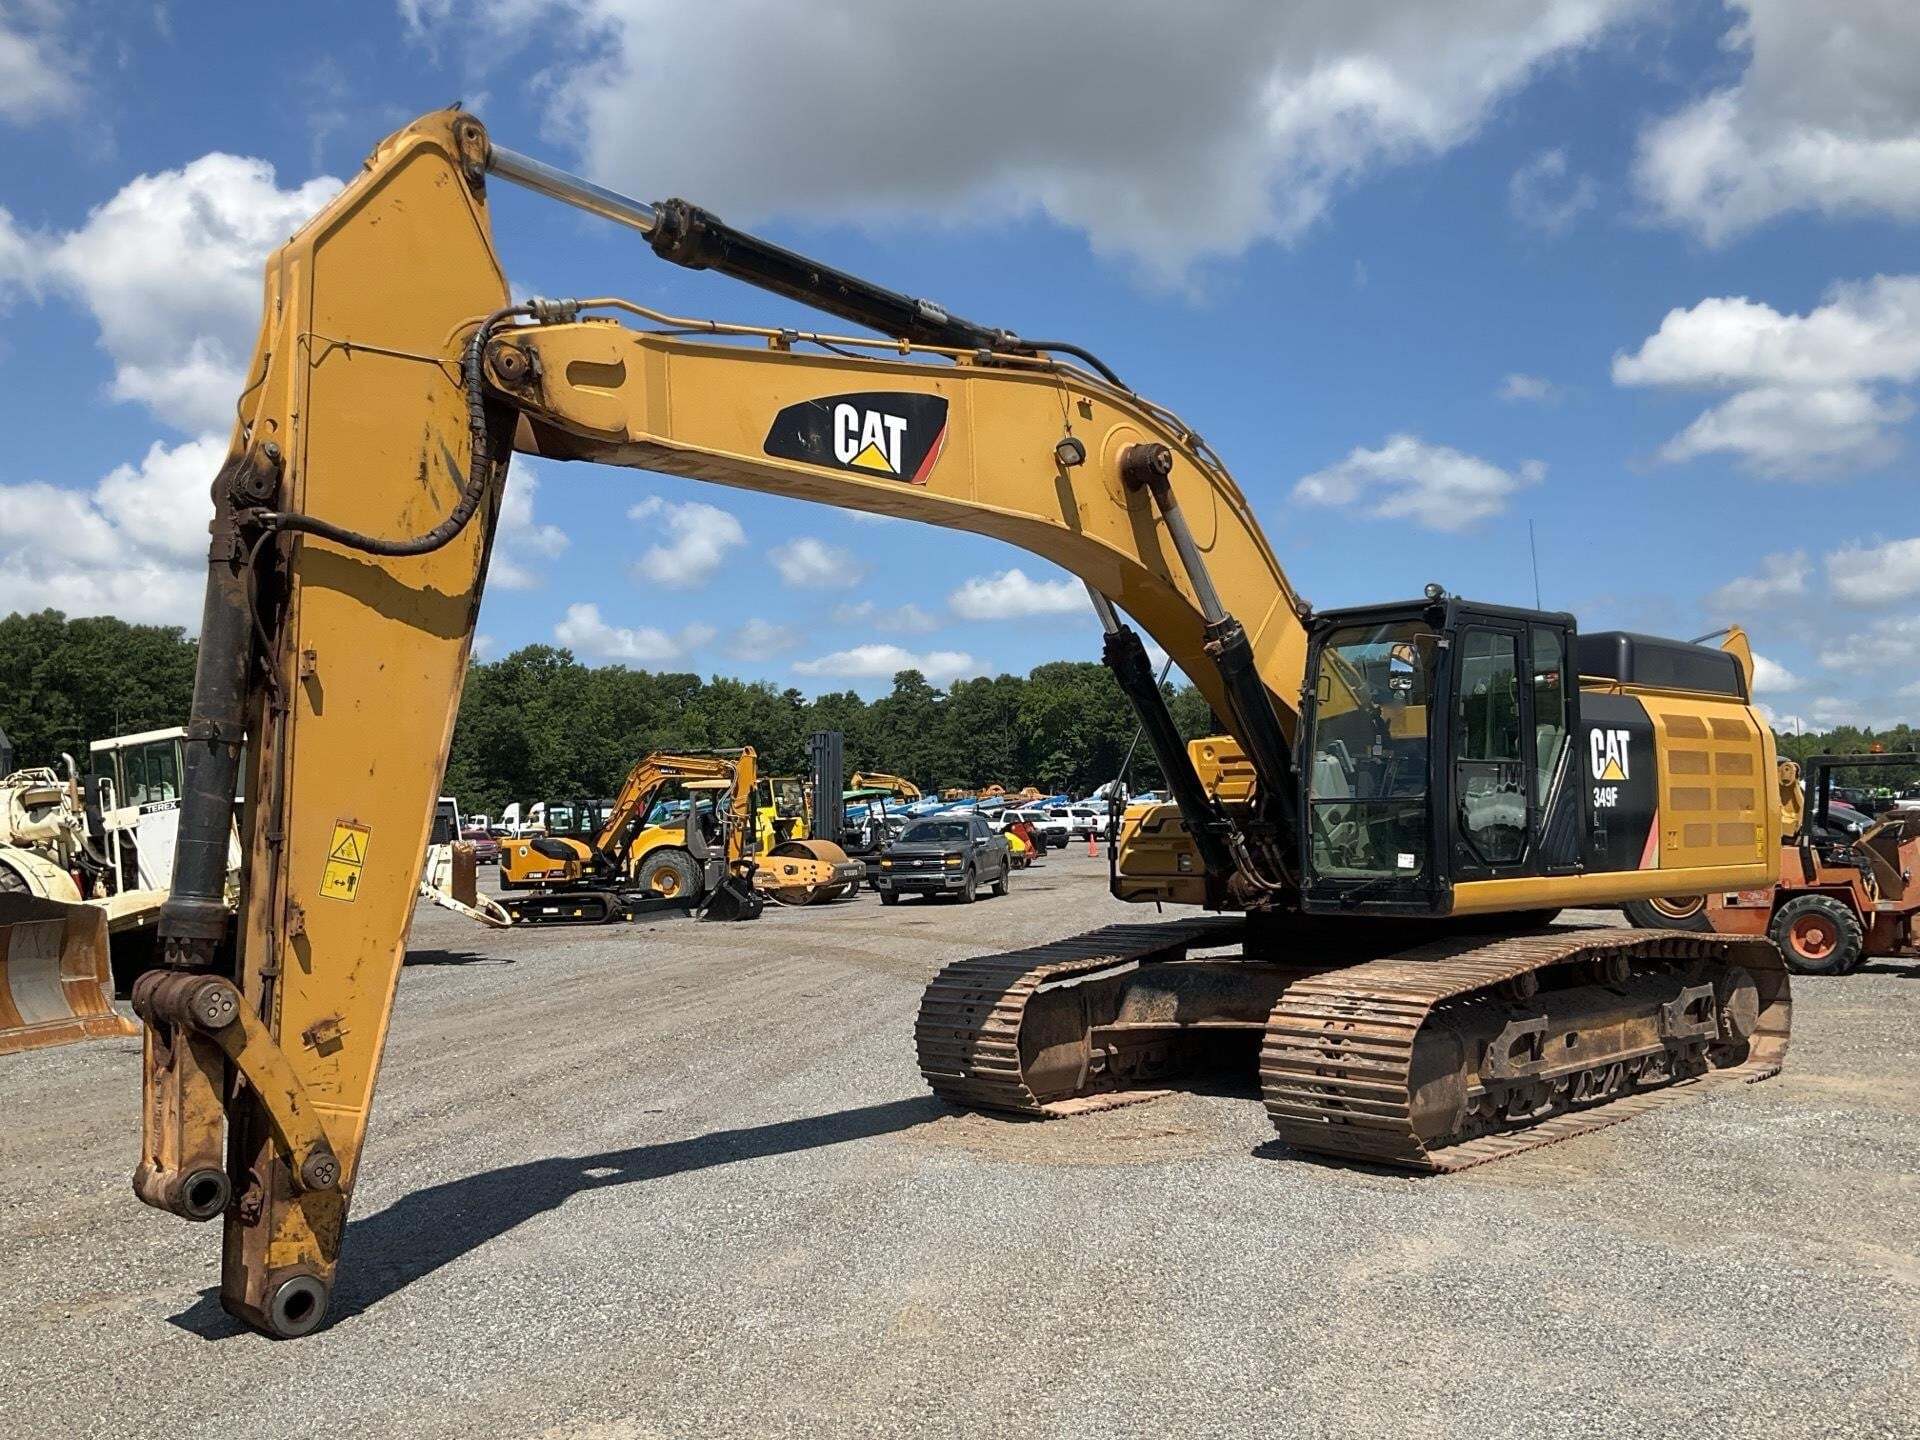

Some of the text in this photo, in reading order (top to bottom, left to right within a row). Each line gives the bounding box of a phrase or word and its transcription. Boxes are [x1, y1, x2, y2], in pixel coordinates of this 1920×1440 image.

[834, 403, 907, 474] CAT
[1590, 728, 1630, 780] CAT
[147, 802, 176, 812] TEREX
[1593, 787, 1618, 807] 349F
